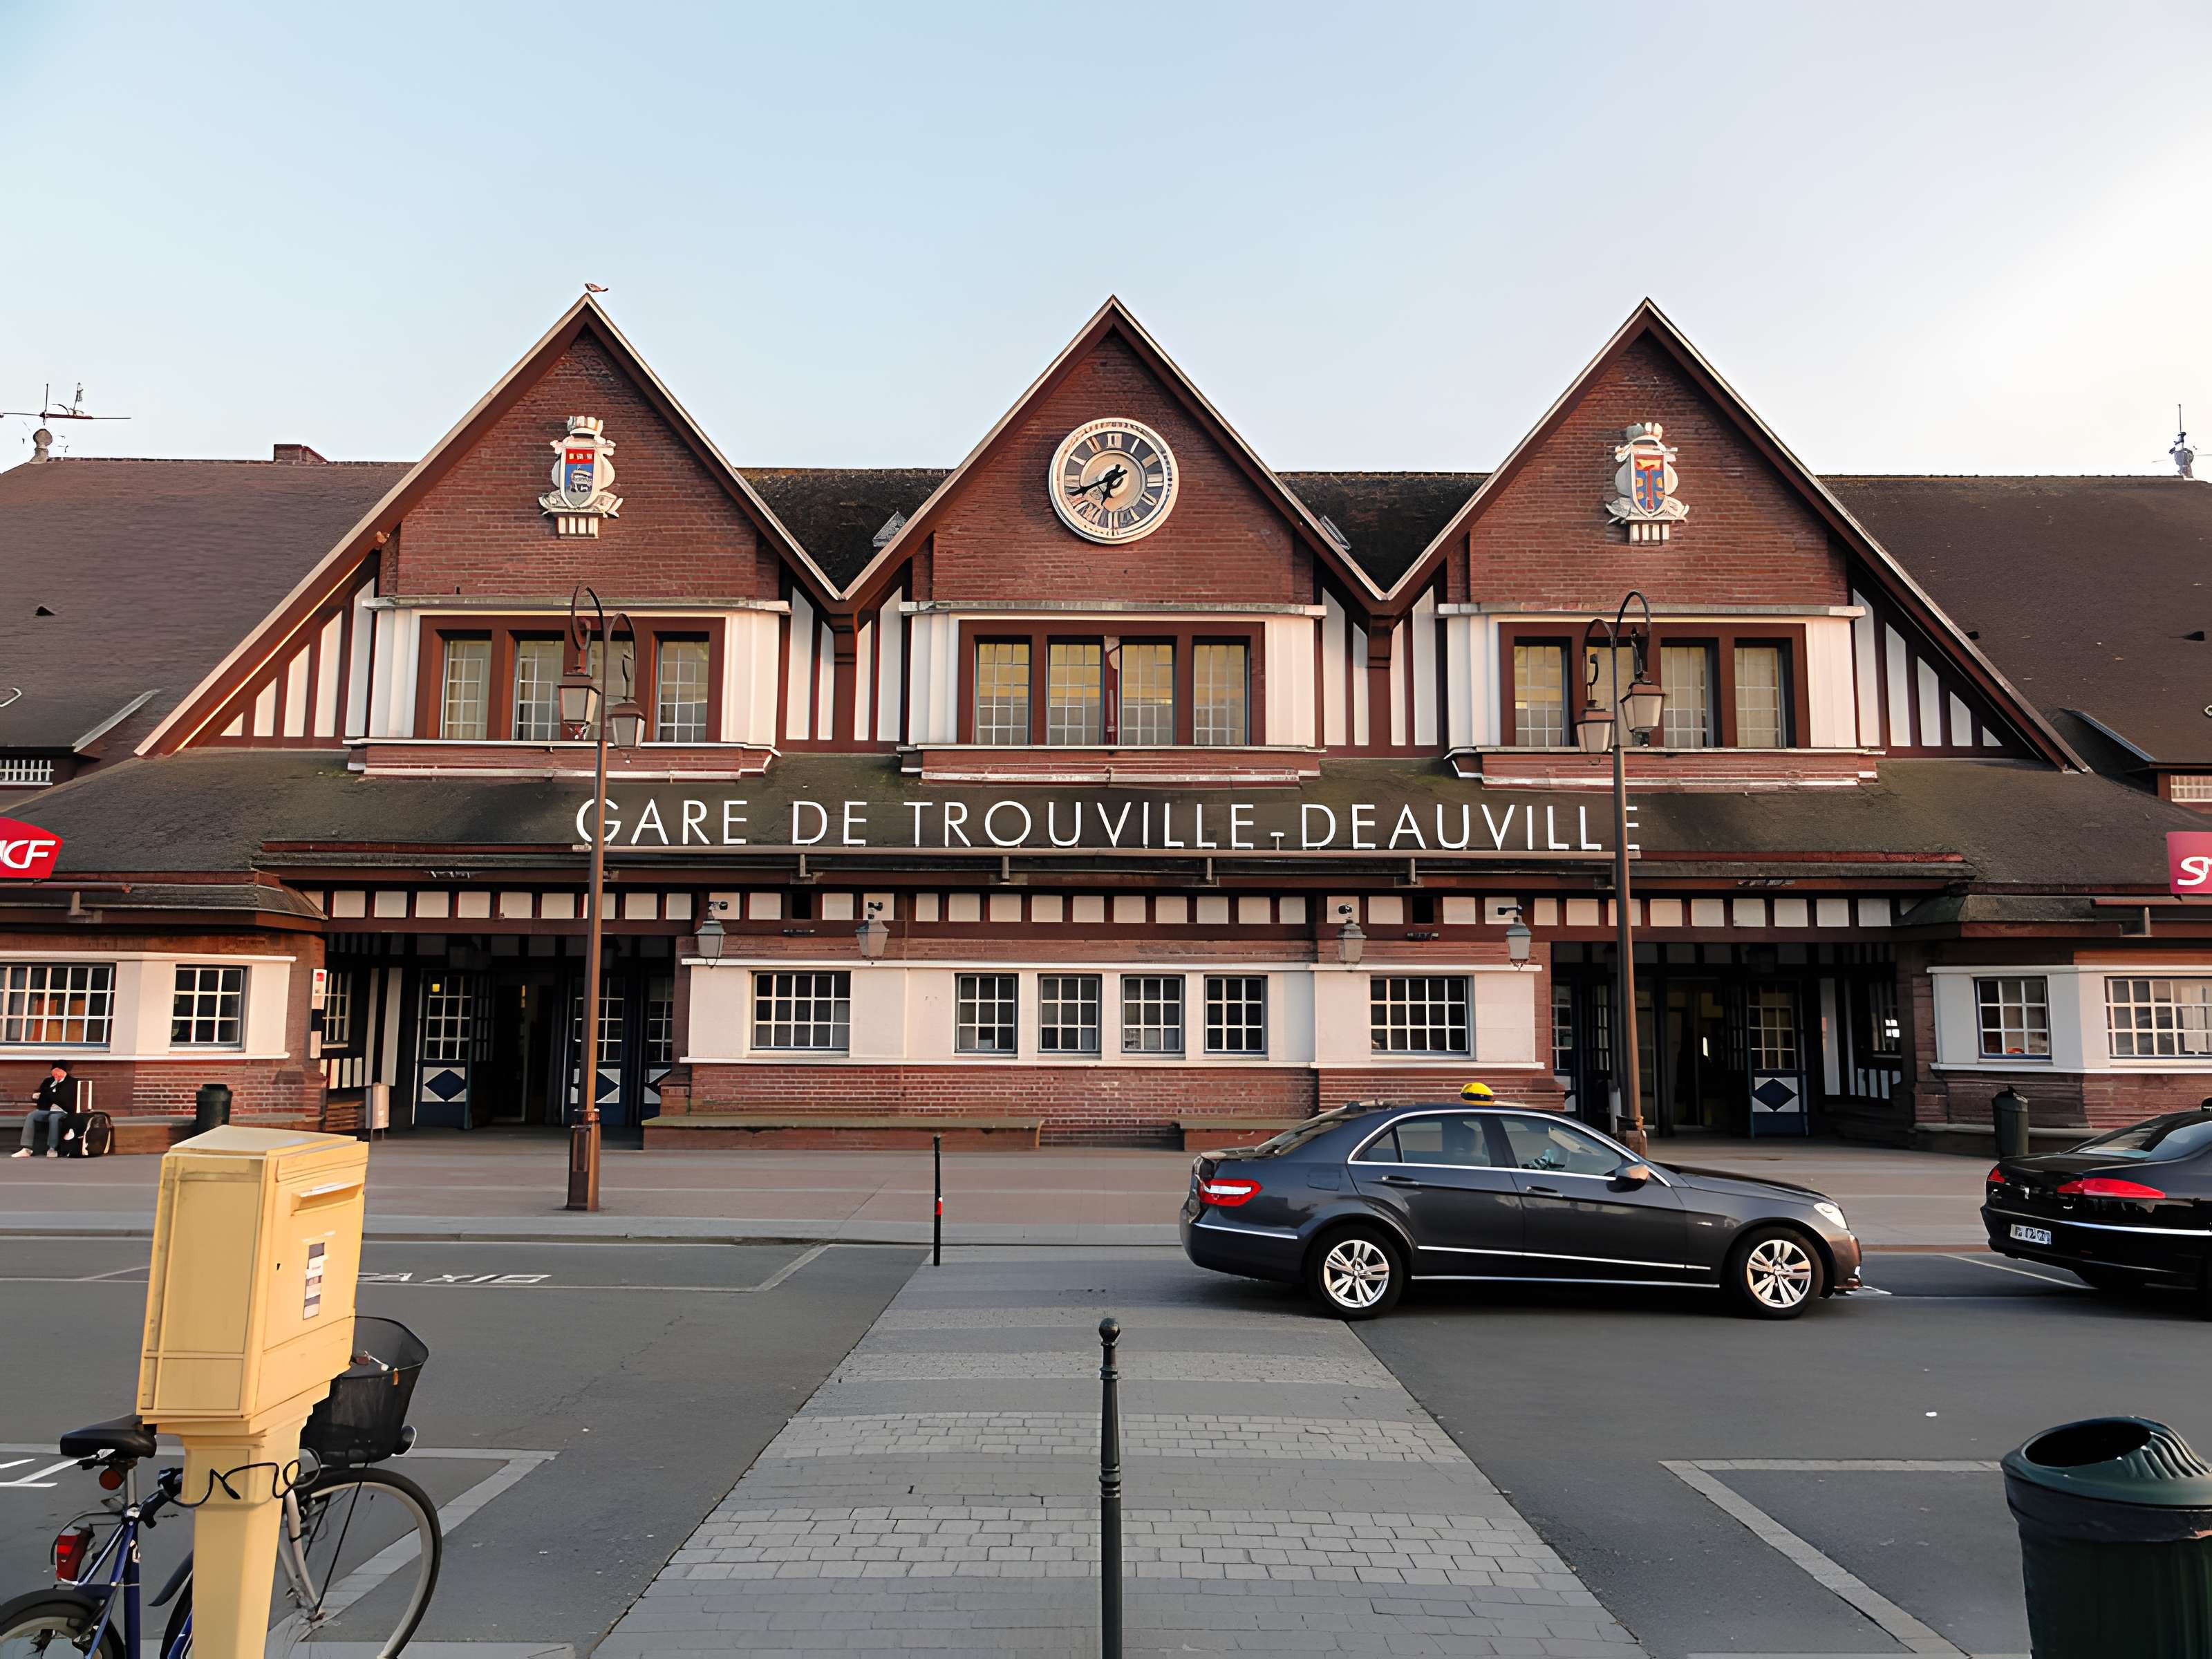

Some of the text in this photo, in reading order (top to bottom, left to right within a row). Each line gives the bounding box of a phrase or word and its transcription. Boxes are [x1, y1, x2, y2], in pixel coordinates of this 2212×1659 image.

[576, 798, 747, 845] GARE
[792, 800, 868, 845] DE
[0, 840, 56, 869] CF
